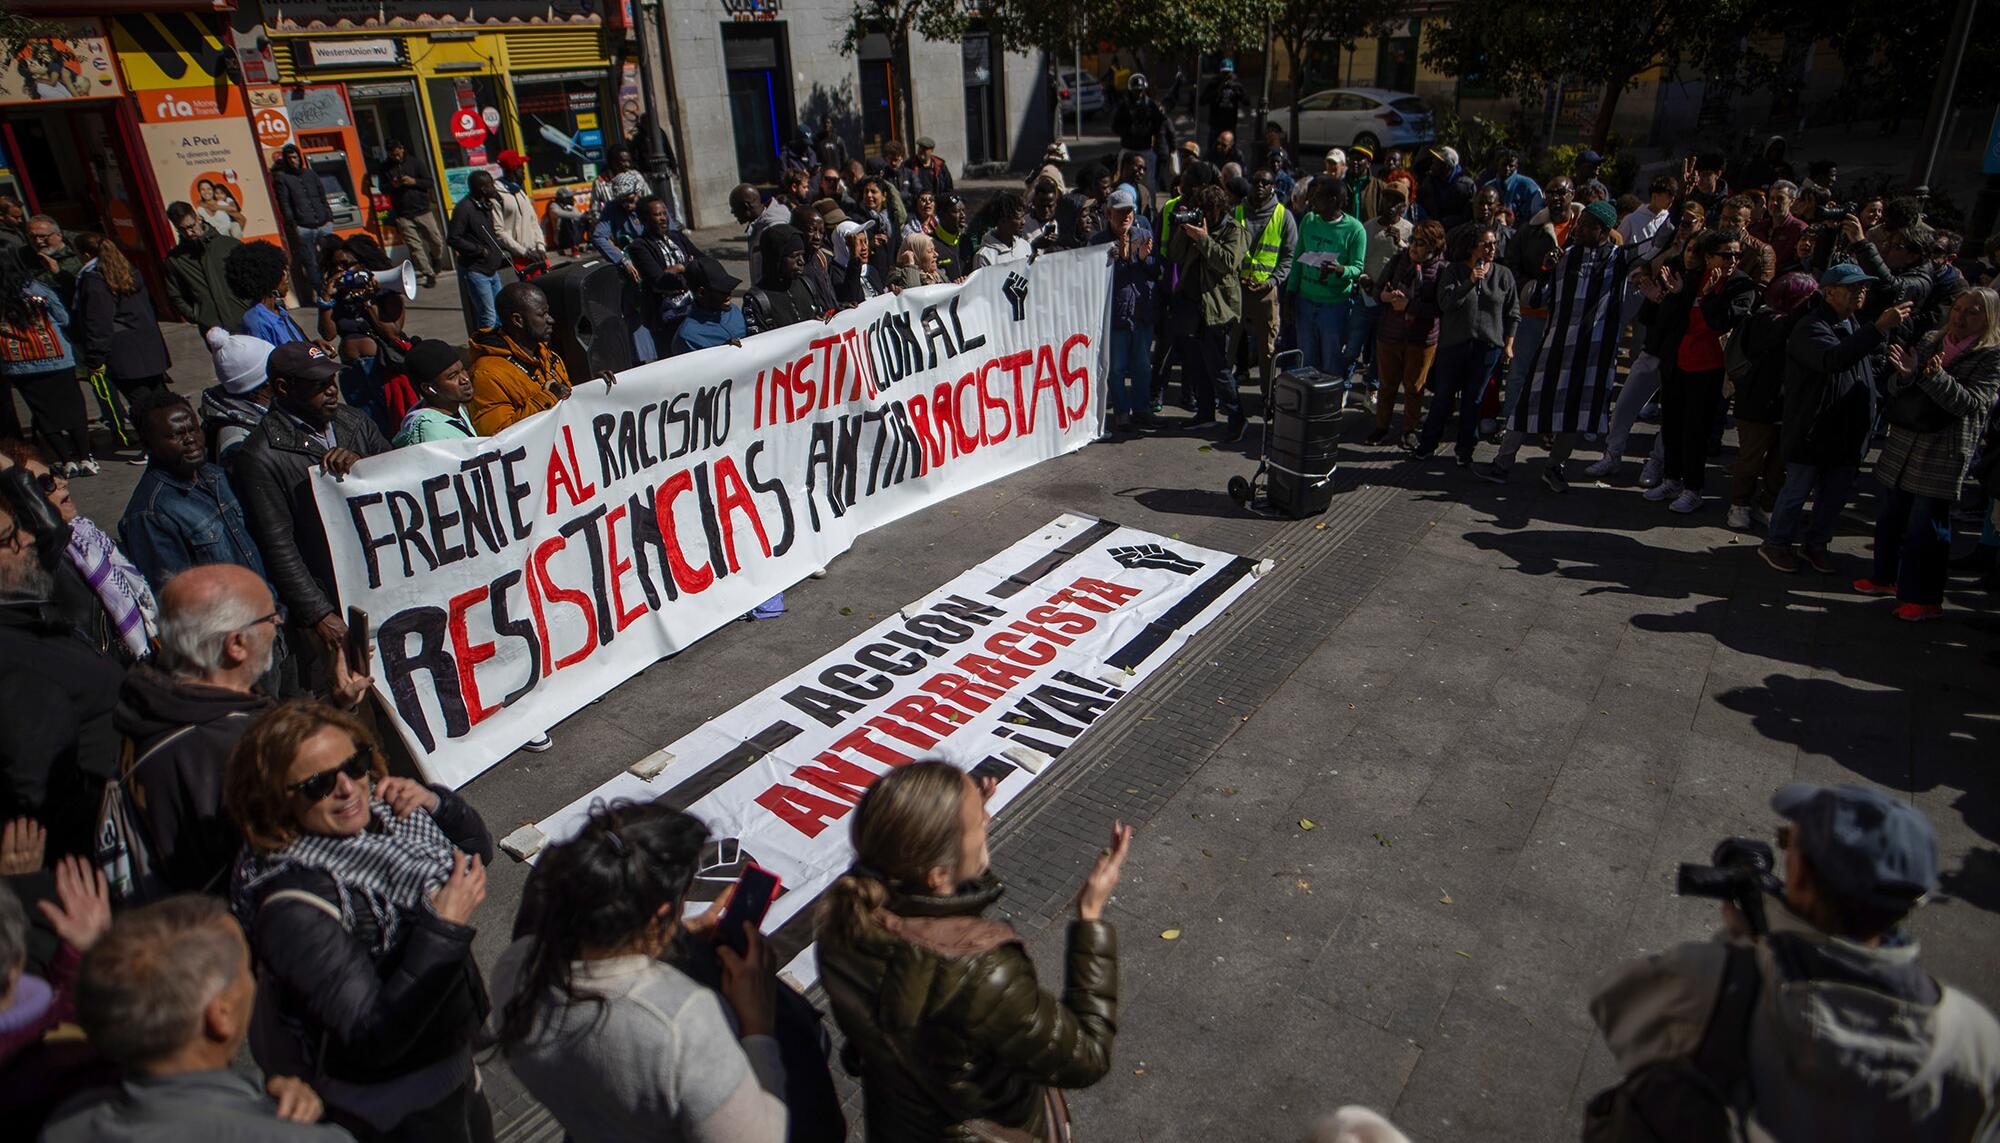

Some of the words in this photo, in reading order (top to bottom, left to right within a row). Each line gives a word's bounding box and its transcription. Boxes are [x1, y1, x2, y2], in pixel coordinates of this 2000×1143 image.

[316, 48, 371, 57] WesternUnion
[157, 94, 193, 118] ria
[182, 137, 192, 147] A
[193, 134, 220, 147] Perú
[257, 113, 287, 134] ria
[346, 446, 534, 589] FRENTE
[547, 425, 595, 514] AL
[593, 379, 732, 488] RACISMO
[753, 295, 986, 430] INSTITUCIONAL
[377, 440, 795, 755] RESISTENCIAS
[806, 333, 1093, 533] ANTIRRACISTAS
[781, 594, 1008, 729] ACCION
[754, 576, 1142, 839] ANTIRRACISTA
